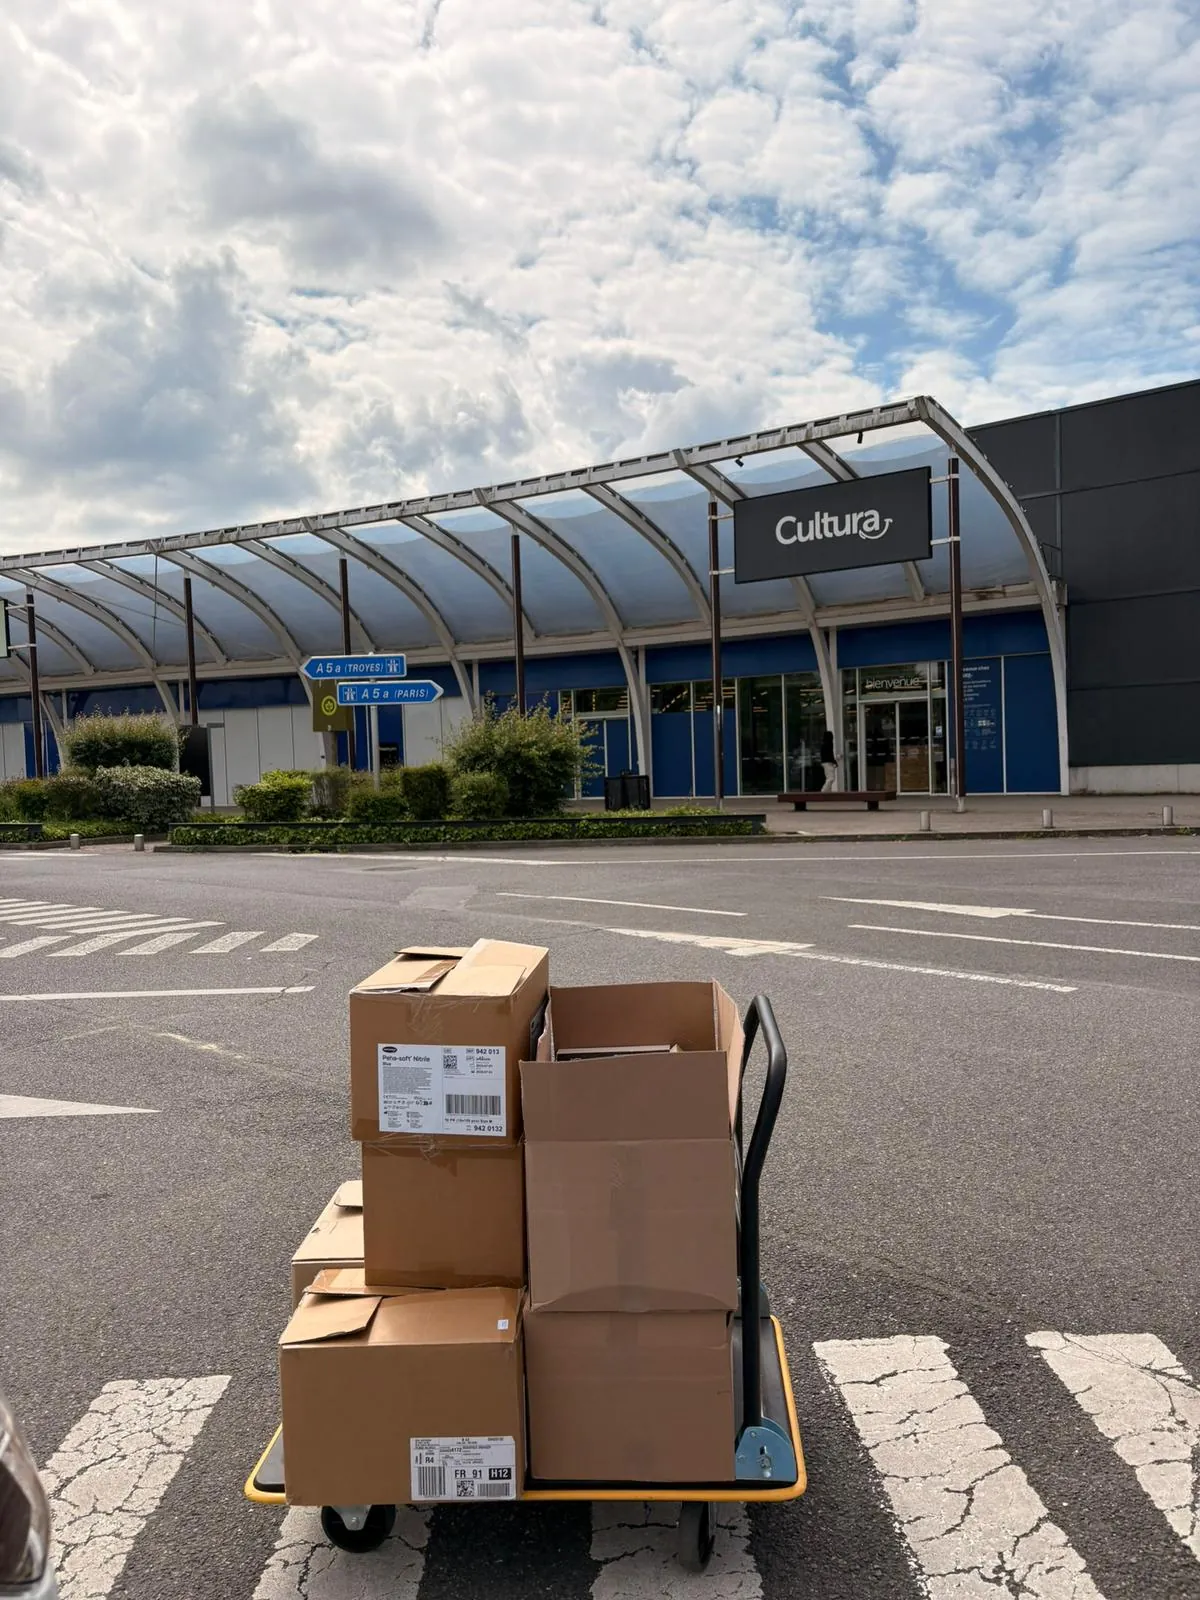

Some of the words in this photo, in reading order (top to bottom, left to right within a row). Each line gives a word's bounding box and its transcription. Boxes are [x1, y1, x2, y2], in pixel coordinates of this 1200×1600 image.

[775, 509, 884, 545] Cultura
[344, 663, 384, 674] (TROYES)
[866, 675, 921, 689] bienvenue
[394, 688, 429, 700] (PARIS)
[454, 1469, 466, 1478] FR
[472, 1469, 482, 1478] 91
[490, 1468, 509, 1479] H12
